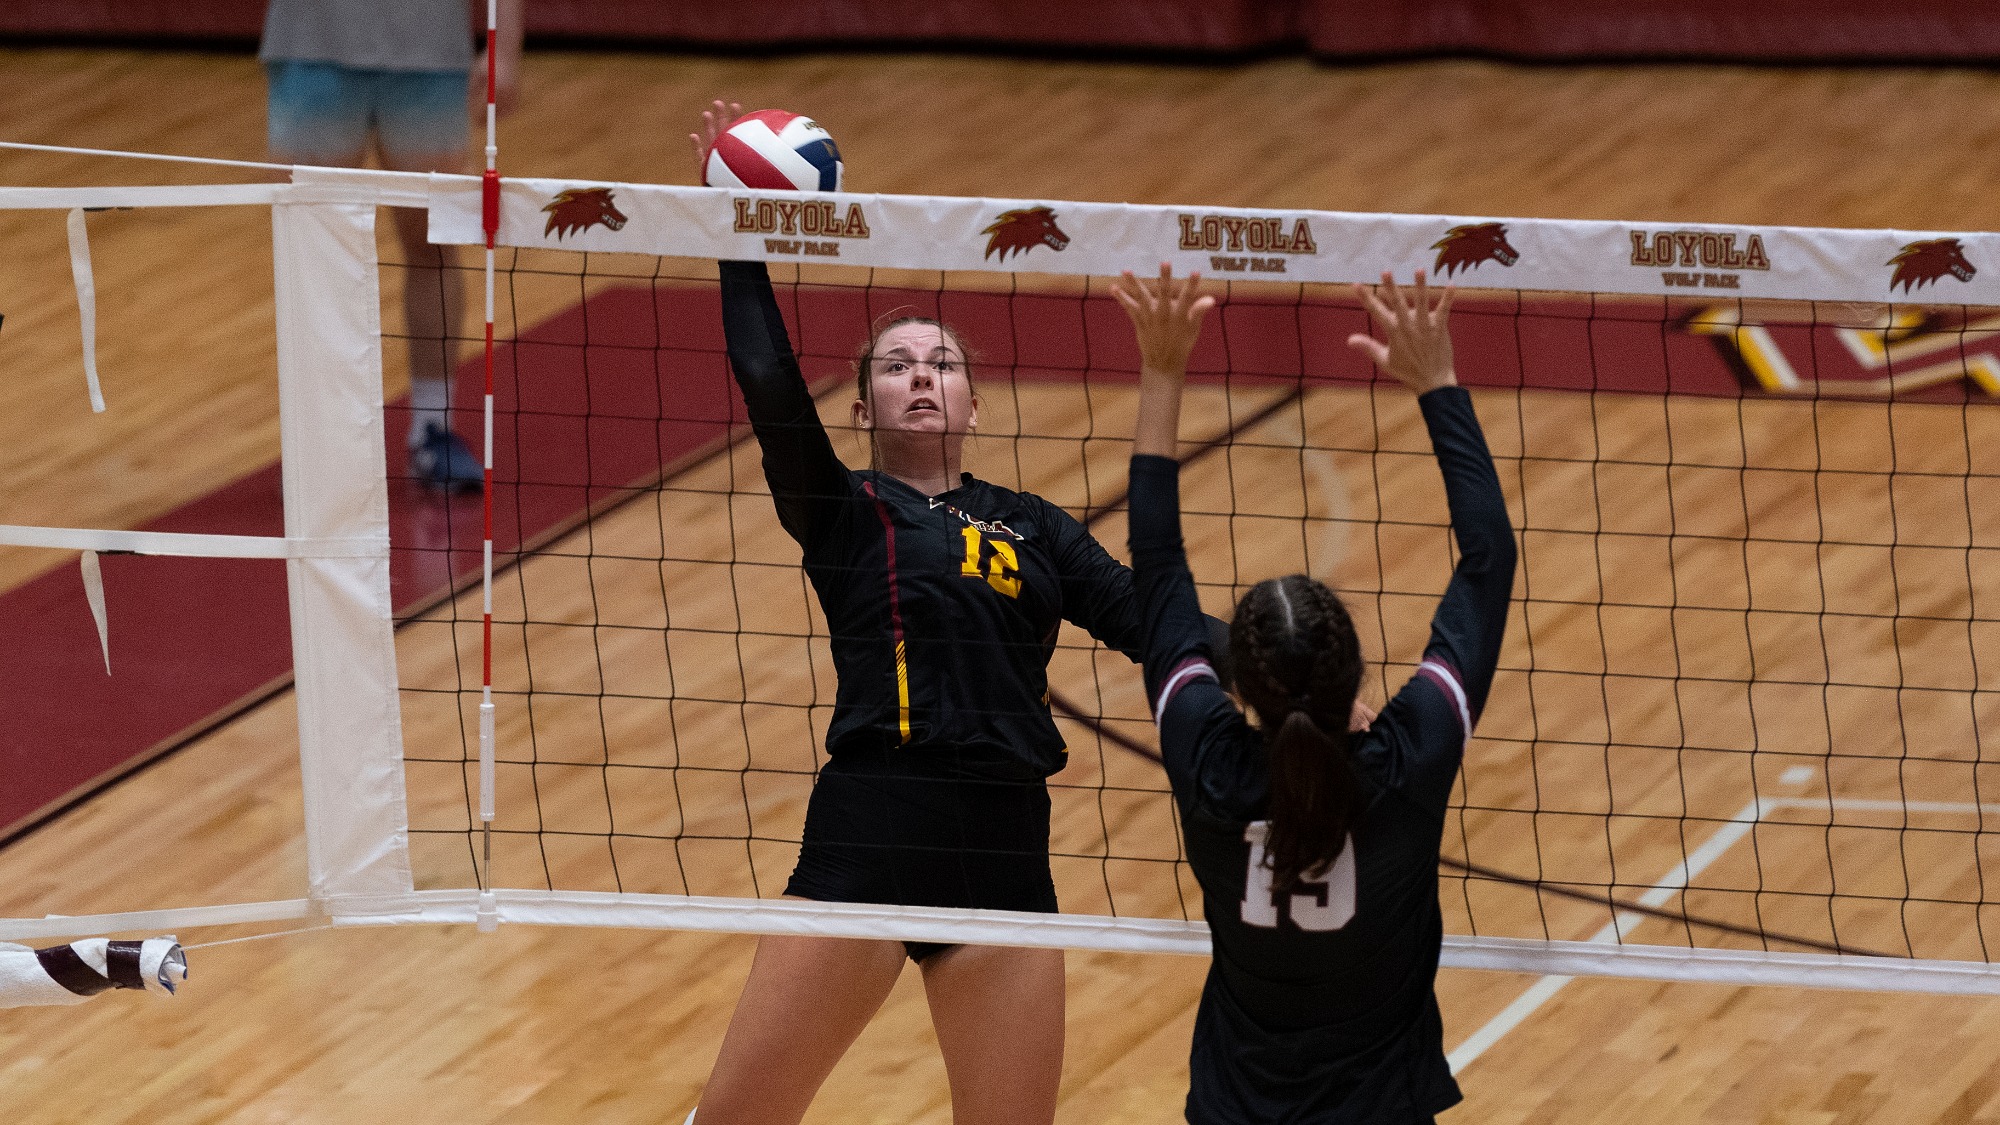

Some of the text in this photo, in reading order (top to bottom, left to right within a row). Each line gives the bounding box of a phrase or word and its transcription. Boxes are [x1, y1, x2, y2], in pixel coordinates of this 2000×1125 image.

[734, 197, 869, 238] LOYOLA
[1178, 213, 1317, 254] LOYOLA
[764, 239, 840, 257] WOLF PACK
[1210, 256, 1286, 273] WOLF PACK
[1630, 230, 1770, 271] LOYOLA
[1661, 272, 1740, 289] WOLF PACK
[960, 525, 1022, 599] 12
